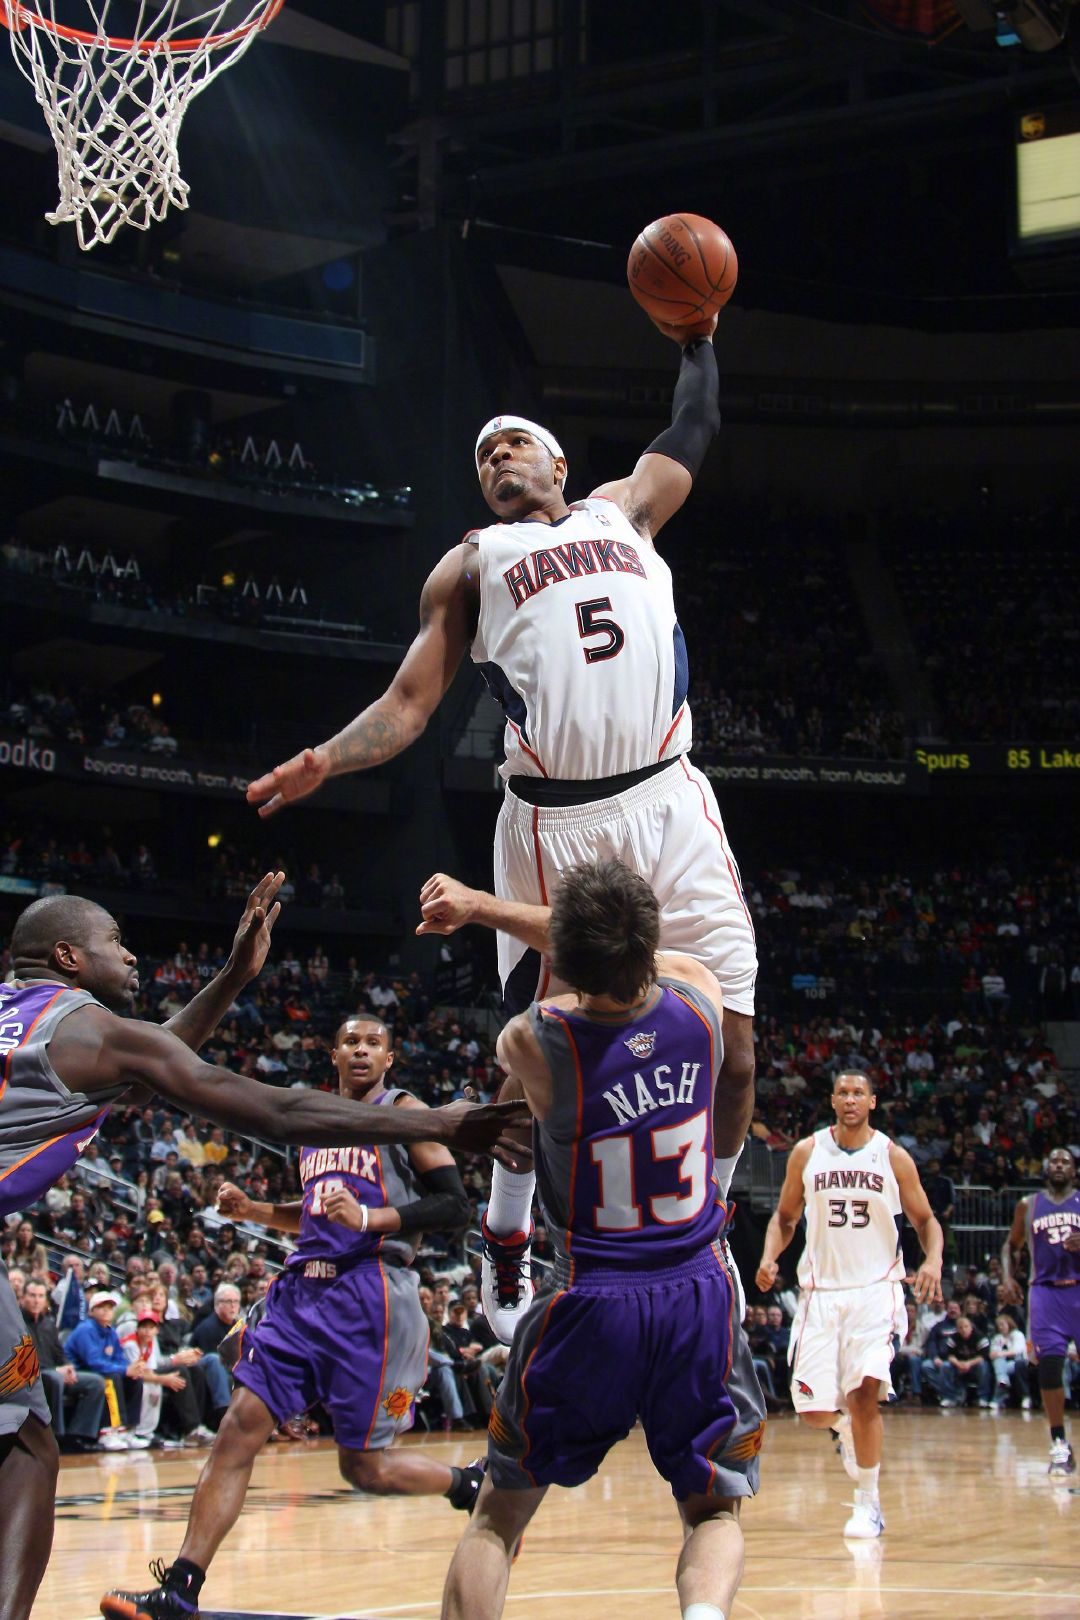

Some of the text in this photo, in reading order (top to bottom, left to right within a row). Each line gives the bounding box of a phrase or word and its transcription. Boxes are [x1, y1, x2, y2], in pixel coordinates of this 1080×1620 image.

[502, 538, 648, 611] HAWKS
[574, 596, 625, 665] 5
[83, 756, 138, 778] beyond
[196, 771, 227, 788] from
[702, 764, 759, 781] beyond
[820, 768, 851, 783] from
[854, 768, 906, 785] Absolut
[914, 748, 970, 773] Spurs
[1007, 748, 1032, 769] 85
[196, 965, 217, 978] 107
[803, 987, 827, 1000] 108
[602, 1062, 702, 1126] NASH
[300, 1146, 377, 1183] PHOENIX
[589, 1107, 709, 1232] 13
[814, 1171, 884, 1193] HAWKS
[828, 1199, 871, 1229] 33
[1047, 1226, 1073, 1245] 32
